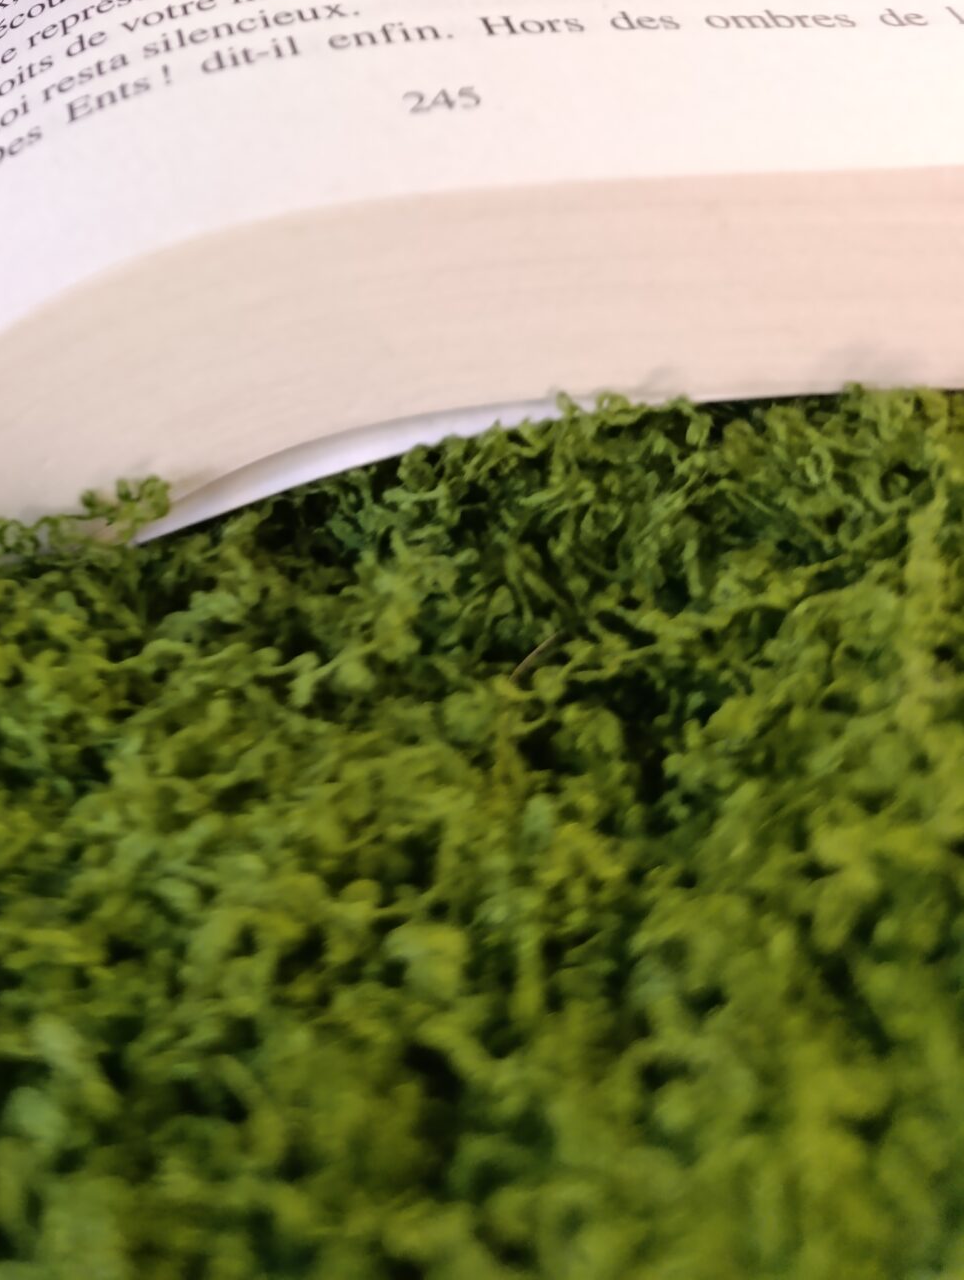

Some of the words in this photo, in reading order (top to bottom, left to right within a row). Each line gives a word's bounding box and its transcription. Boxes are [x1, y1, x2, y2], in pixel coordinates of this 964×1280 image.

[41, 51, 131, 104] resta
[142, 1, 361, 60] silencieux.
[65, 29, 109, 59] de
[65, 74, 153, 126] Ents
[199, 33, 303, 75] dit-il
[326, 20, 456, 51] enfin.
[476, 15, 587, 37] Hors
[609, 10, 682, 32] des
[703, 9, 858, 31] ombres
[878, 7, 930, 28] de
[401, 84, 483, 115] 245
